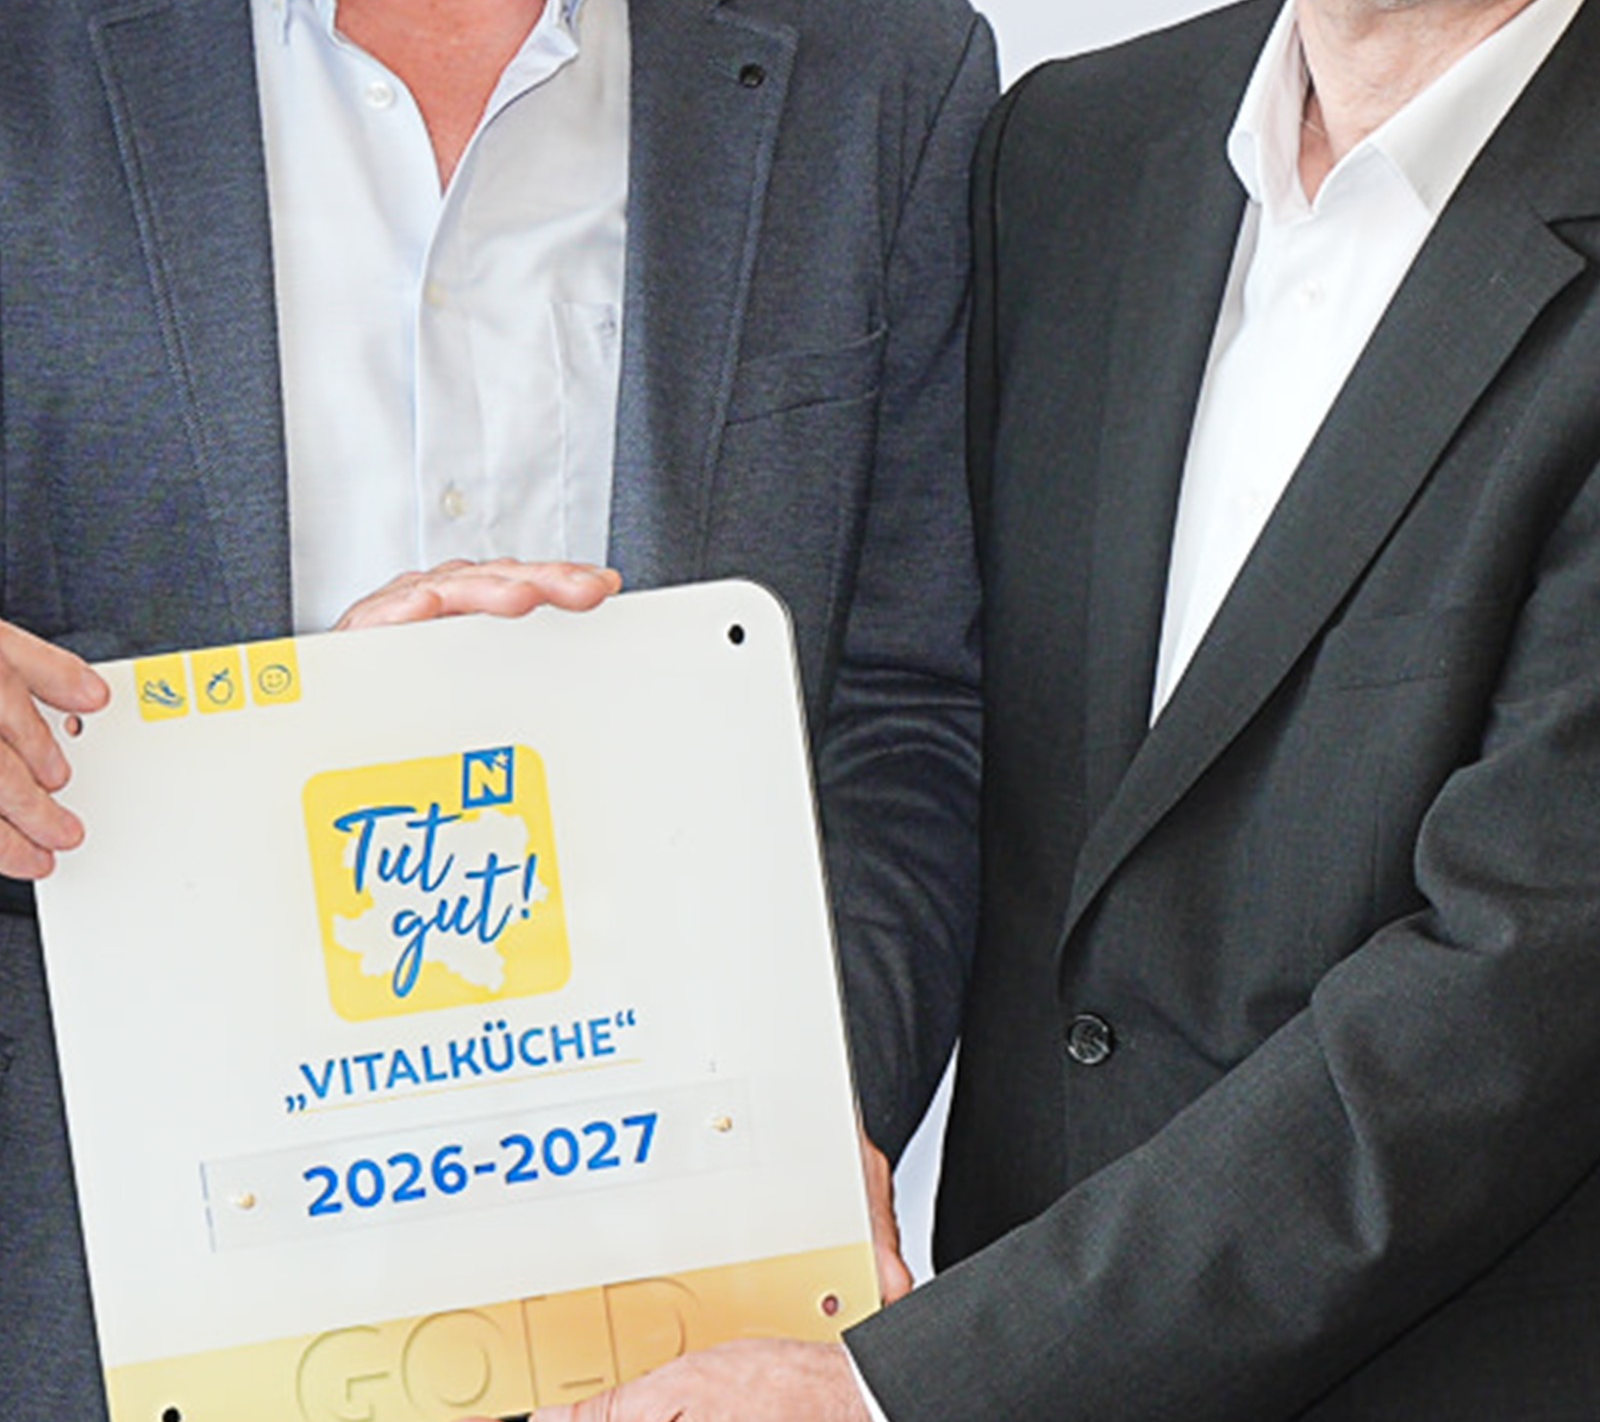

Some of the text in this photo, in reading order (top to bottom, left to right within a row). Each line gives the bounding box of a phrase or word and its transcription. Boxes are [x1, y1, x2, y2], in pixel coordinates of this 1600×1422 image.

[335, 803, 460, 893] Tut
[392, 852, 537, 998] gut!
[302, 1113, 659, 1217] 2026-2027
